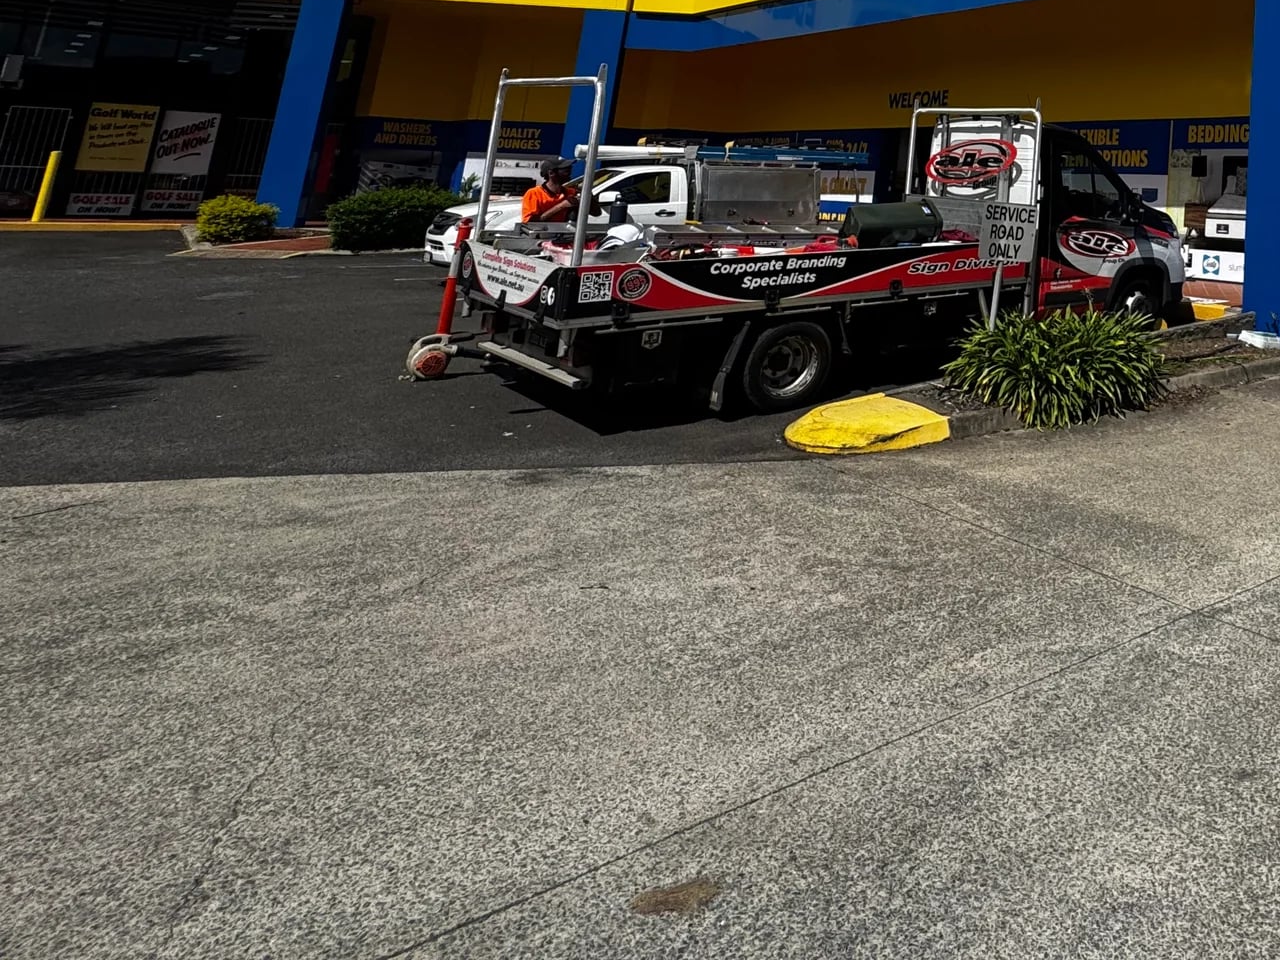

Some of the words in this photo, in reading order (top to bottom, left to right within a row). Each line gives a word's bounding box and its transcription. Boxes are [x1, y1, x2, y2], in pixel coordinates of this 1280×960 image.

[889, 89, 949, 108] WELCOME
[91, 107, 118, 118] Golf
[121, 109, 157, 120] World
[159, 117, 217, 143] CATALOGUE
[383, 121, 433, 135] WASHERS
[1187, 123, 1249, 144] BEDDING
[373, 133, 399, 145] AND
[399, 134, 438, 146] DRYERS
[497, 138, 542, 150] OUNGES
[157, 144, 180, 159] OUT
[72, 195, 101, 204] GOLF
[146, 191, 172, 201] GOLF
[176, 192, 200, 201] SALE
[985, 204, 1036, 223] SERVICE
[990, 224, 1024, 241] ROAD
[988, 243, 1021, 259] ONLY
[710, 259, 783, 276] Corporate
[786, 255, 847, 270] Branding
[907, 261, 950, 275] Sign
[741, 271, 816, 290] Specialists
